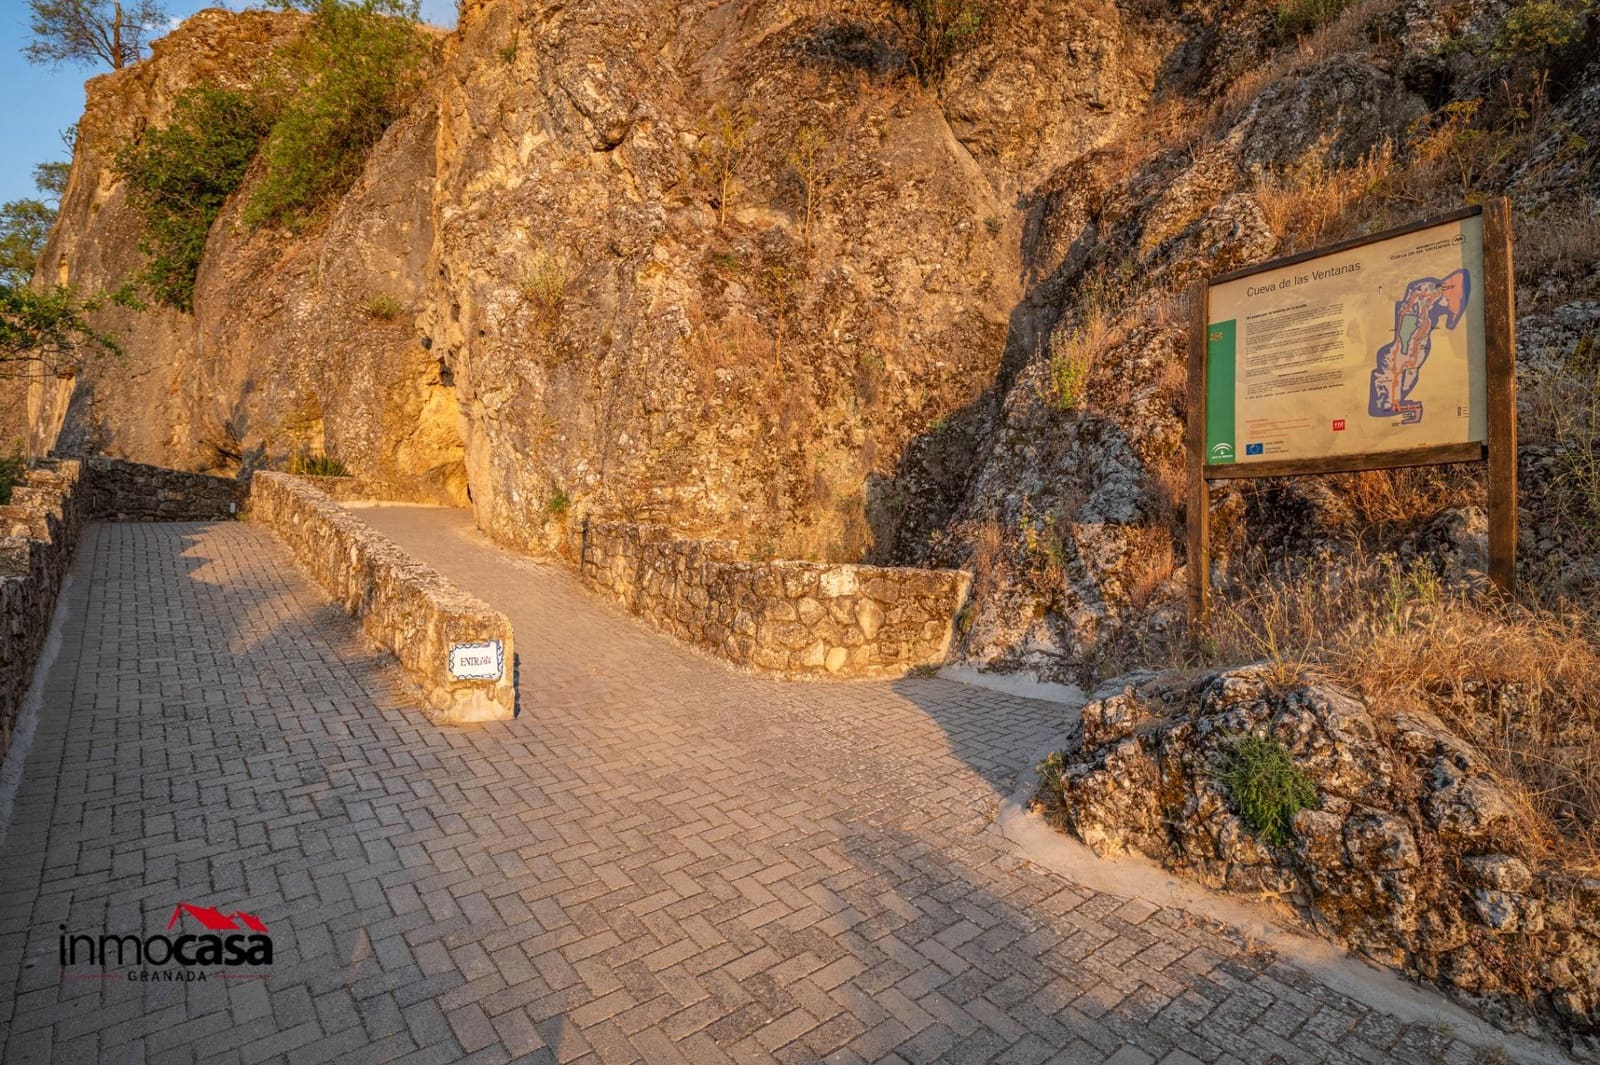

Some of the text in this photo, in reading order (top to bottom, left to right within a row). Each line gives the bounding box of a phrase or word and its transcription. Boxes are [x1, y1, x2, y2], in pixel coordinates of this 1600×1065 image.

[1246, 262, 1361, 297] Cueva de las Ventanas
